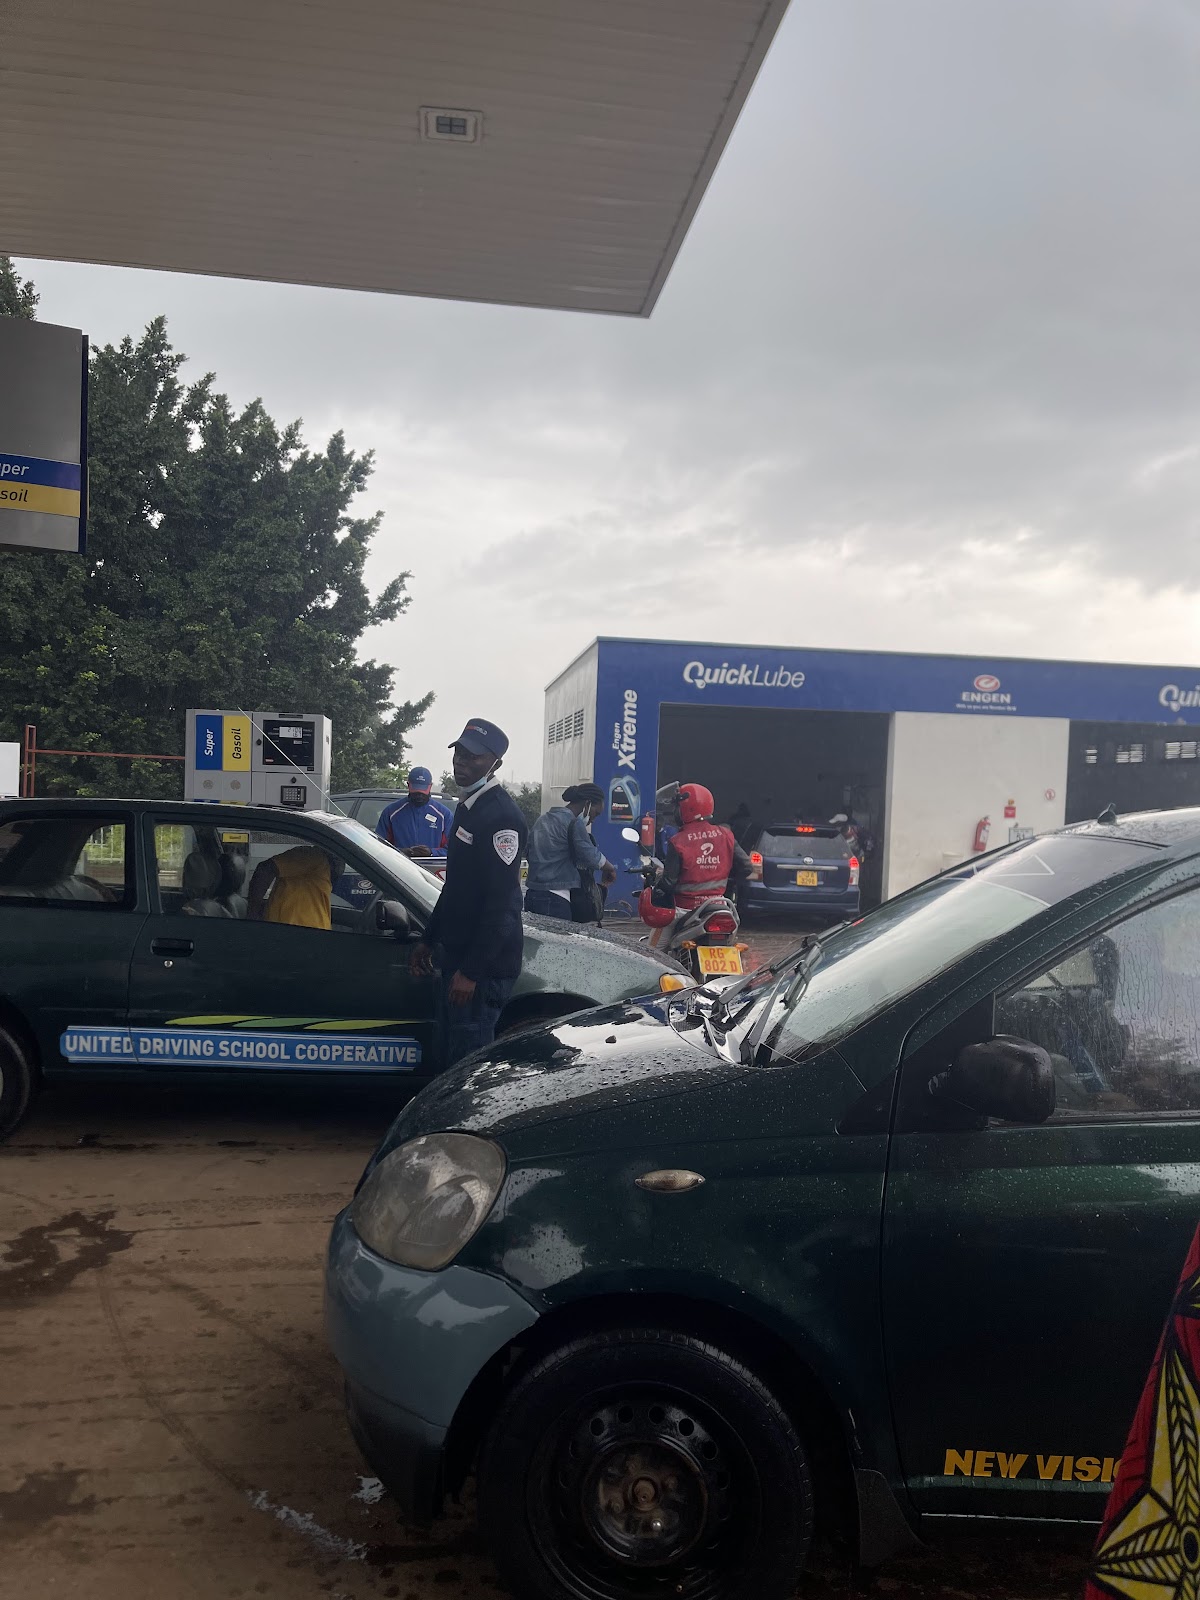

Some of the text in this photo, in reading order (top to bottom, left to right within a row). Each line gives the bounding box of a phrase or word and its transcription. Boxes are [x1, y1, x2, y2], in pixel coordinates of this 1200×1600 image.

[0, 462, 30, 477] per
[0, 489, 28, 502] soil
[961, 691, 1011, 704] ENGEN
[1158, 684, 1200, 712] Qui
[204, 729, 215, 756] Super
[231, 728, 242, 759] Gasoil
[612, 722, 620, 750] Engen
[618, 689, 638, 771] Xtreme
[696, 855, 720, 865] airtel
[705, 960, 738, 972] 802 D
[709, 948, 724, 958] RG
[65, 1034, 417, 1063] UNITED DRIVING SCHOOL COOPERATIVE
[943, 1449, 1121, 1482] NEW VISI
